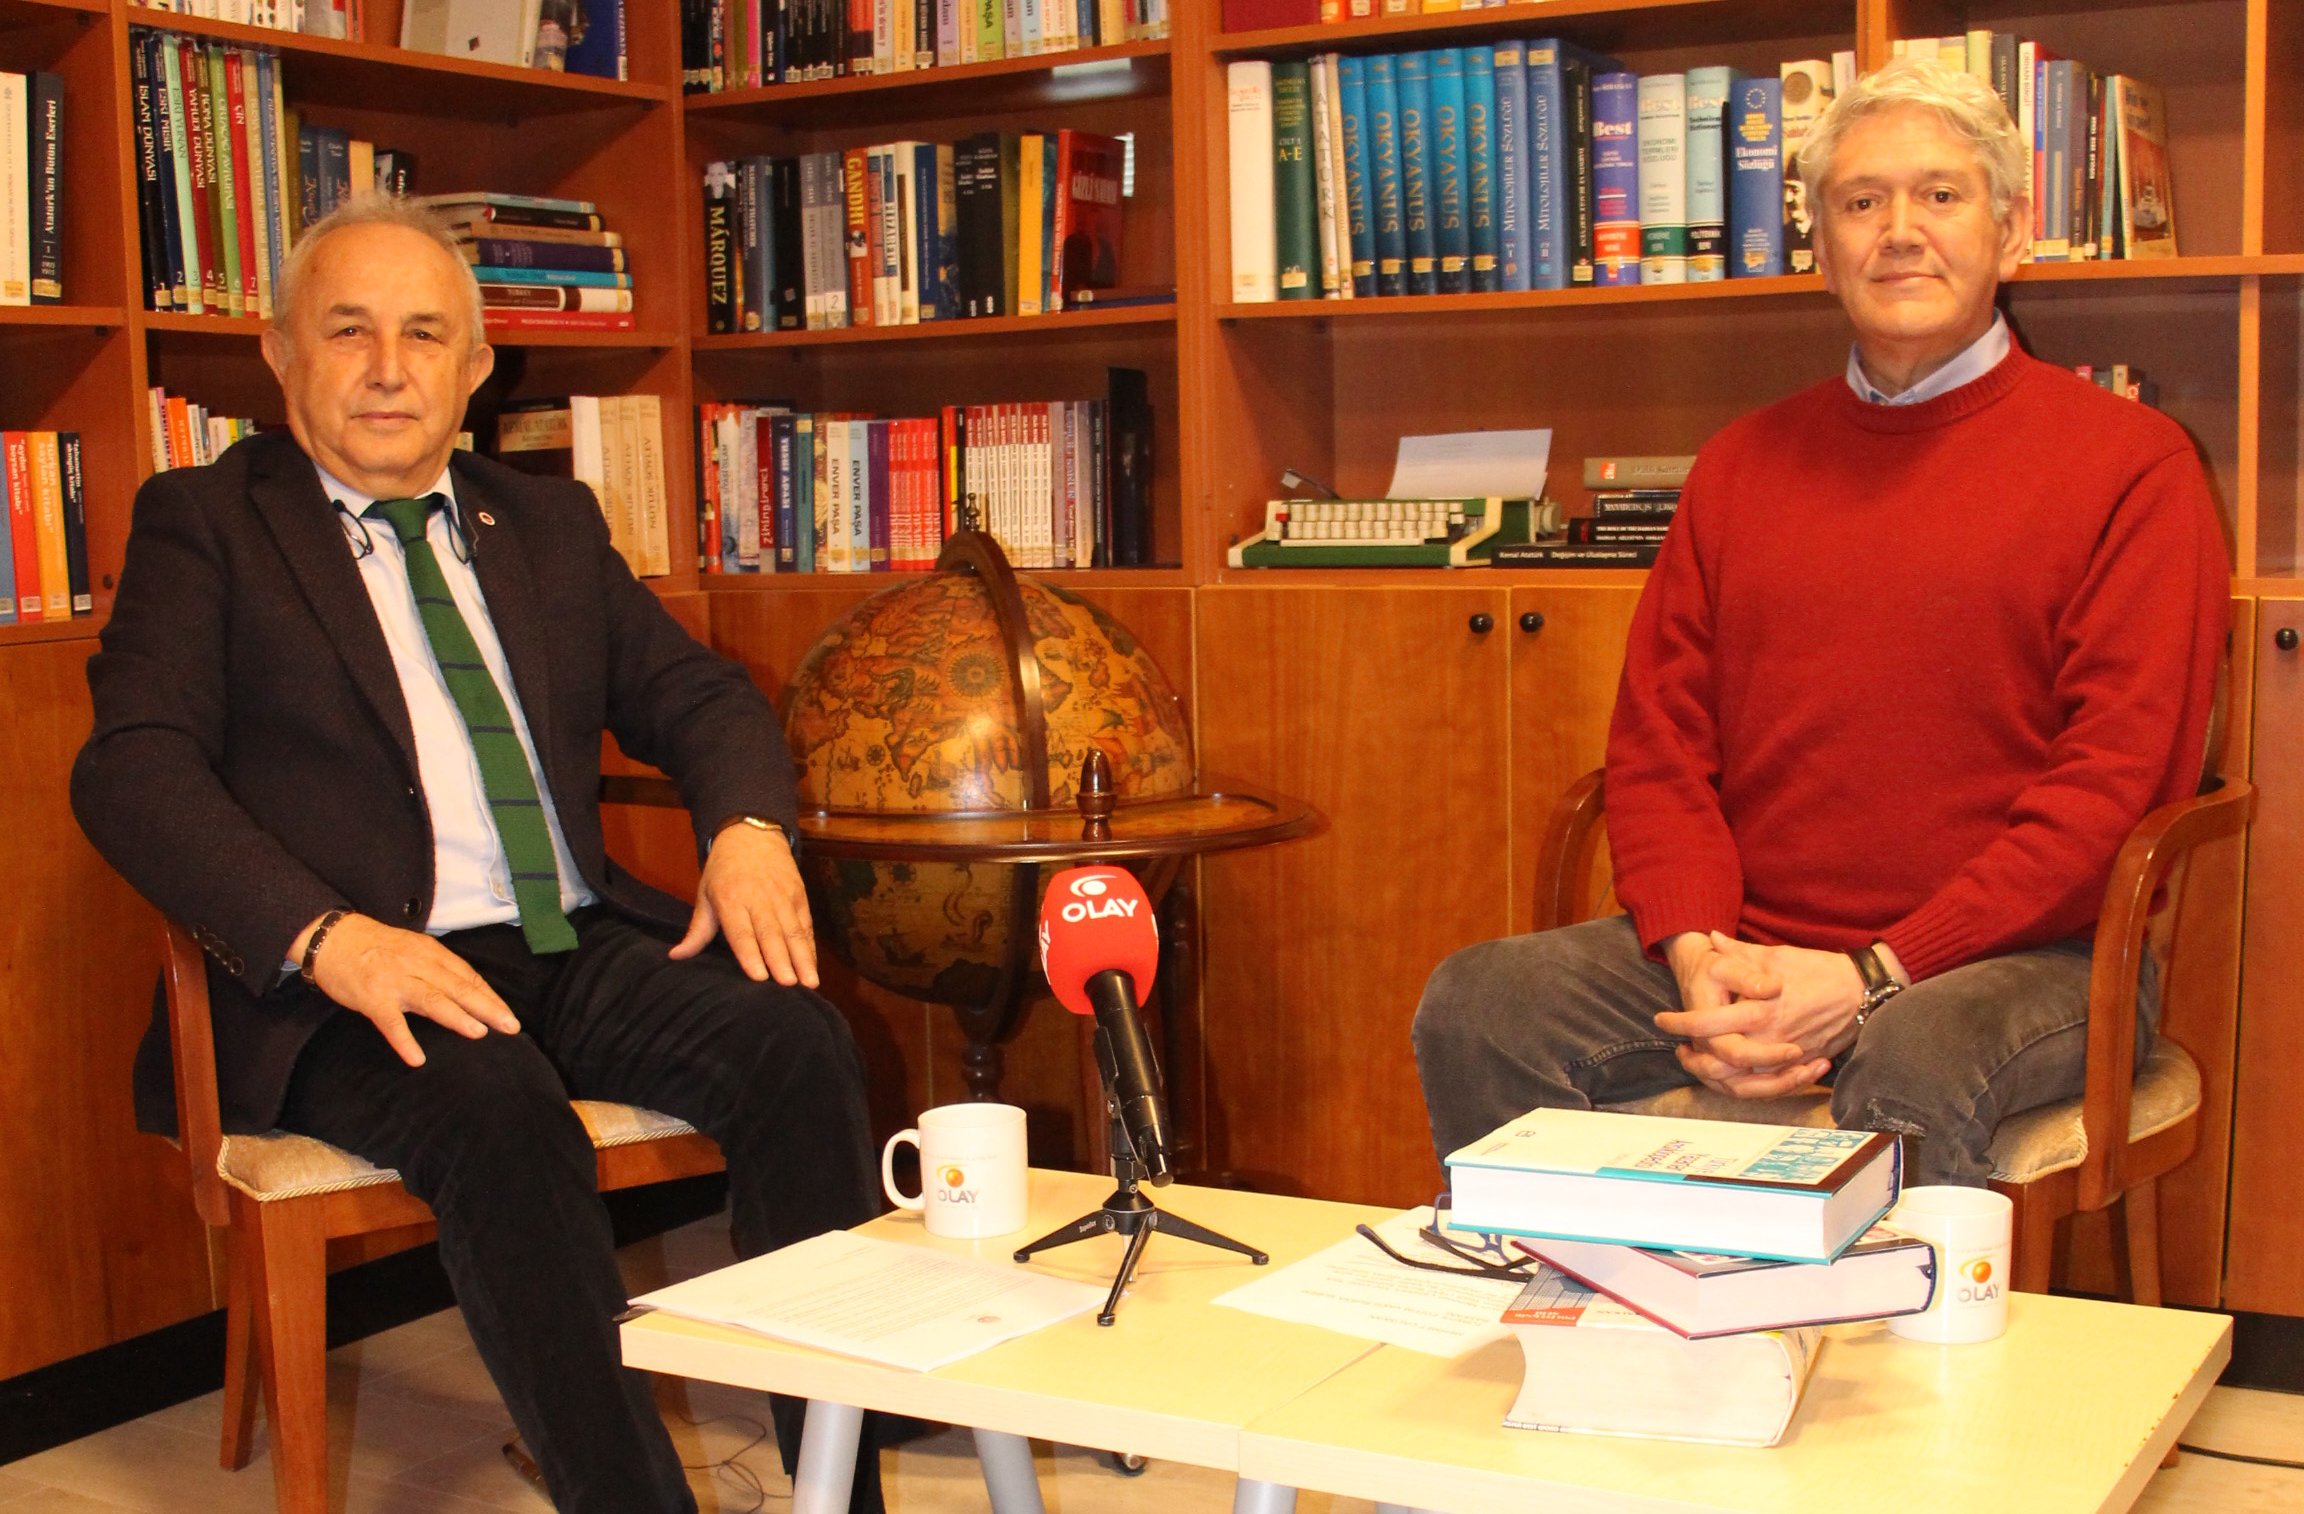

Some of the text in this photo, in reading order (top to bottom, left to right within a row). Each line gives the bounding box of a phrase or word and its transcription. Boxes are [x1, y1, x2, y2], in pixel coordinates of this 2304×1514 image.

[1439, 105, 1460, 229] OKYANUS
[1470, 102, 1490, 228] OKYANUS
[1593, 121, 1633, 137] Best
[1735, 146, 1778, 157] Ekonomi
[847, 157, 864, 225] GANDHI
[1343, 114, 1365, 236] OKYANUS
[1374, 111, 1398, 234] OKYANUS
[1403, 108, 1425, 231] OKYANUS
[710, 205, 729, 305] MÁRQUEZ
[830, 458, 840, 535] ENVER PAŞA
[851, 459, 861, 536] ENVER PAŞA
[1061, 898, 1138, 923] OLAY
[937, 1189, 979, 1203] OLAY
[1957, 1283, 1999, 1302] OLAY
